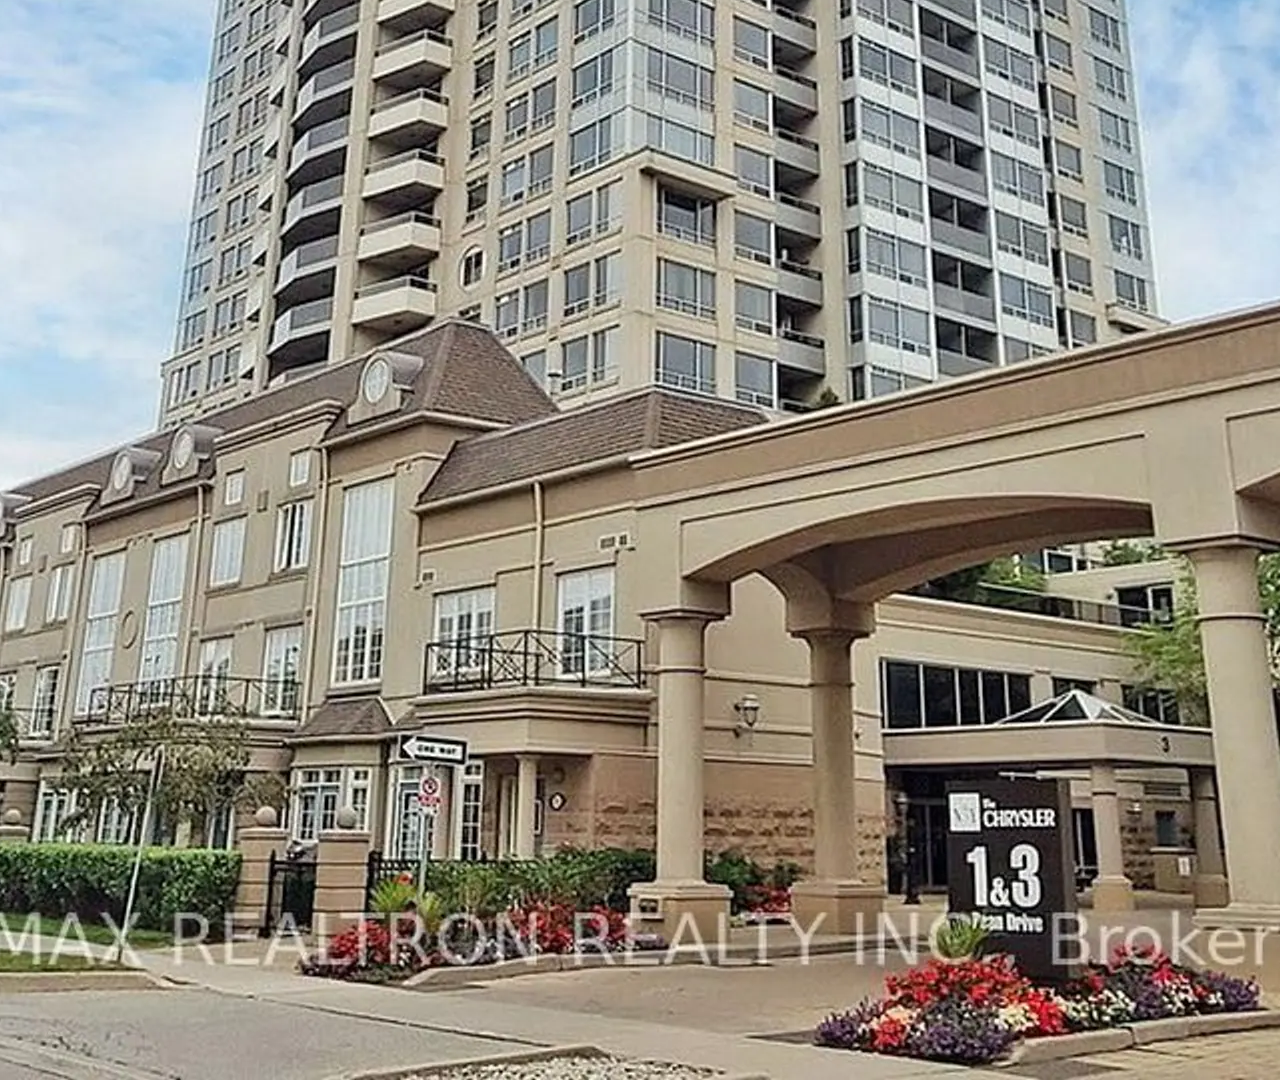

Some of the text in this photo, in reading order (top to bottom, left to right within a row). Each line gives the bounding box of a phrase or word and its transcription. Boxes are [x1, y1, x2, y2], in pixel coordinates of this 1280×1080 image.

[1161, 736, 1170, 753] 3
[983, 808, 1056, 828] CHRYSLER
[1006, 912, 1044, 933] Drive
